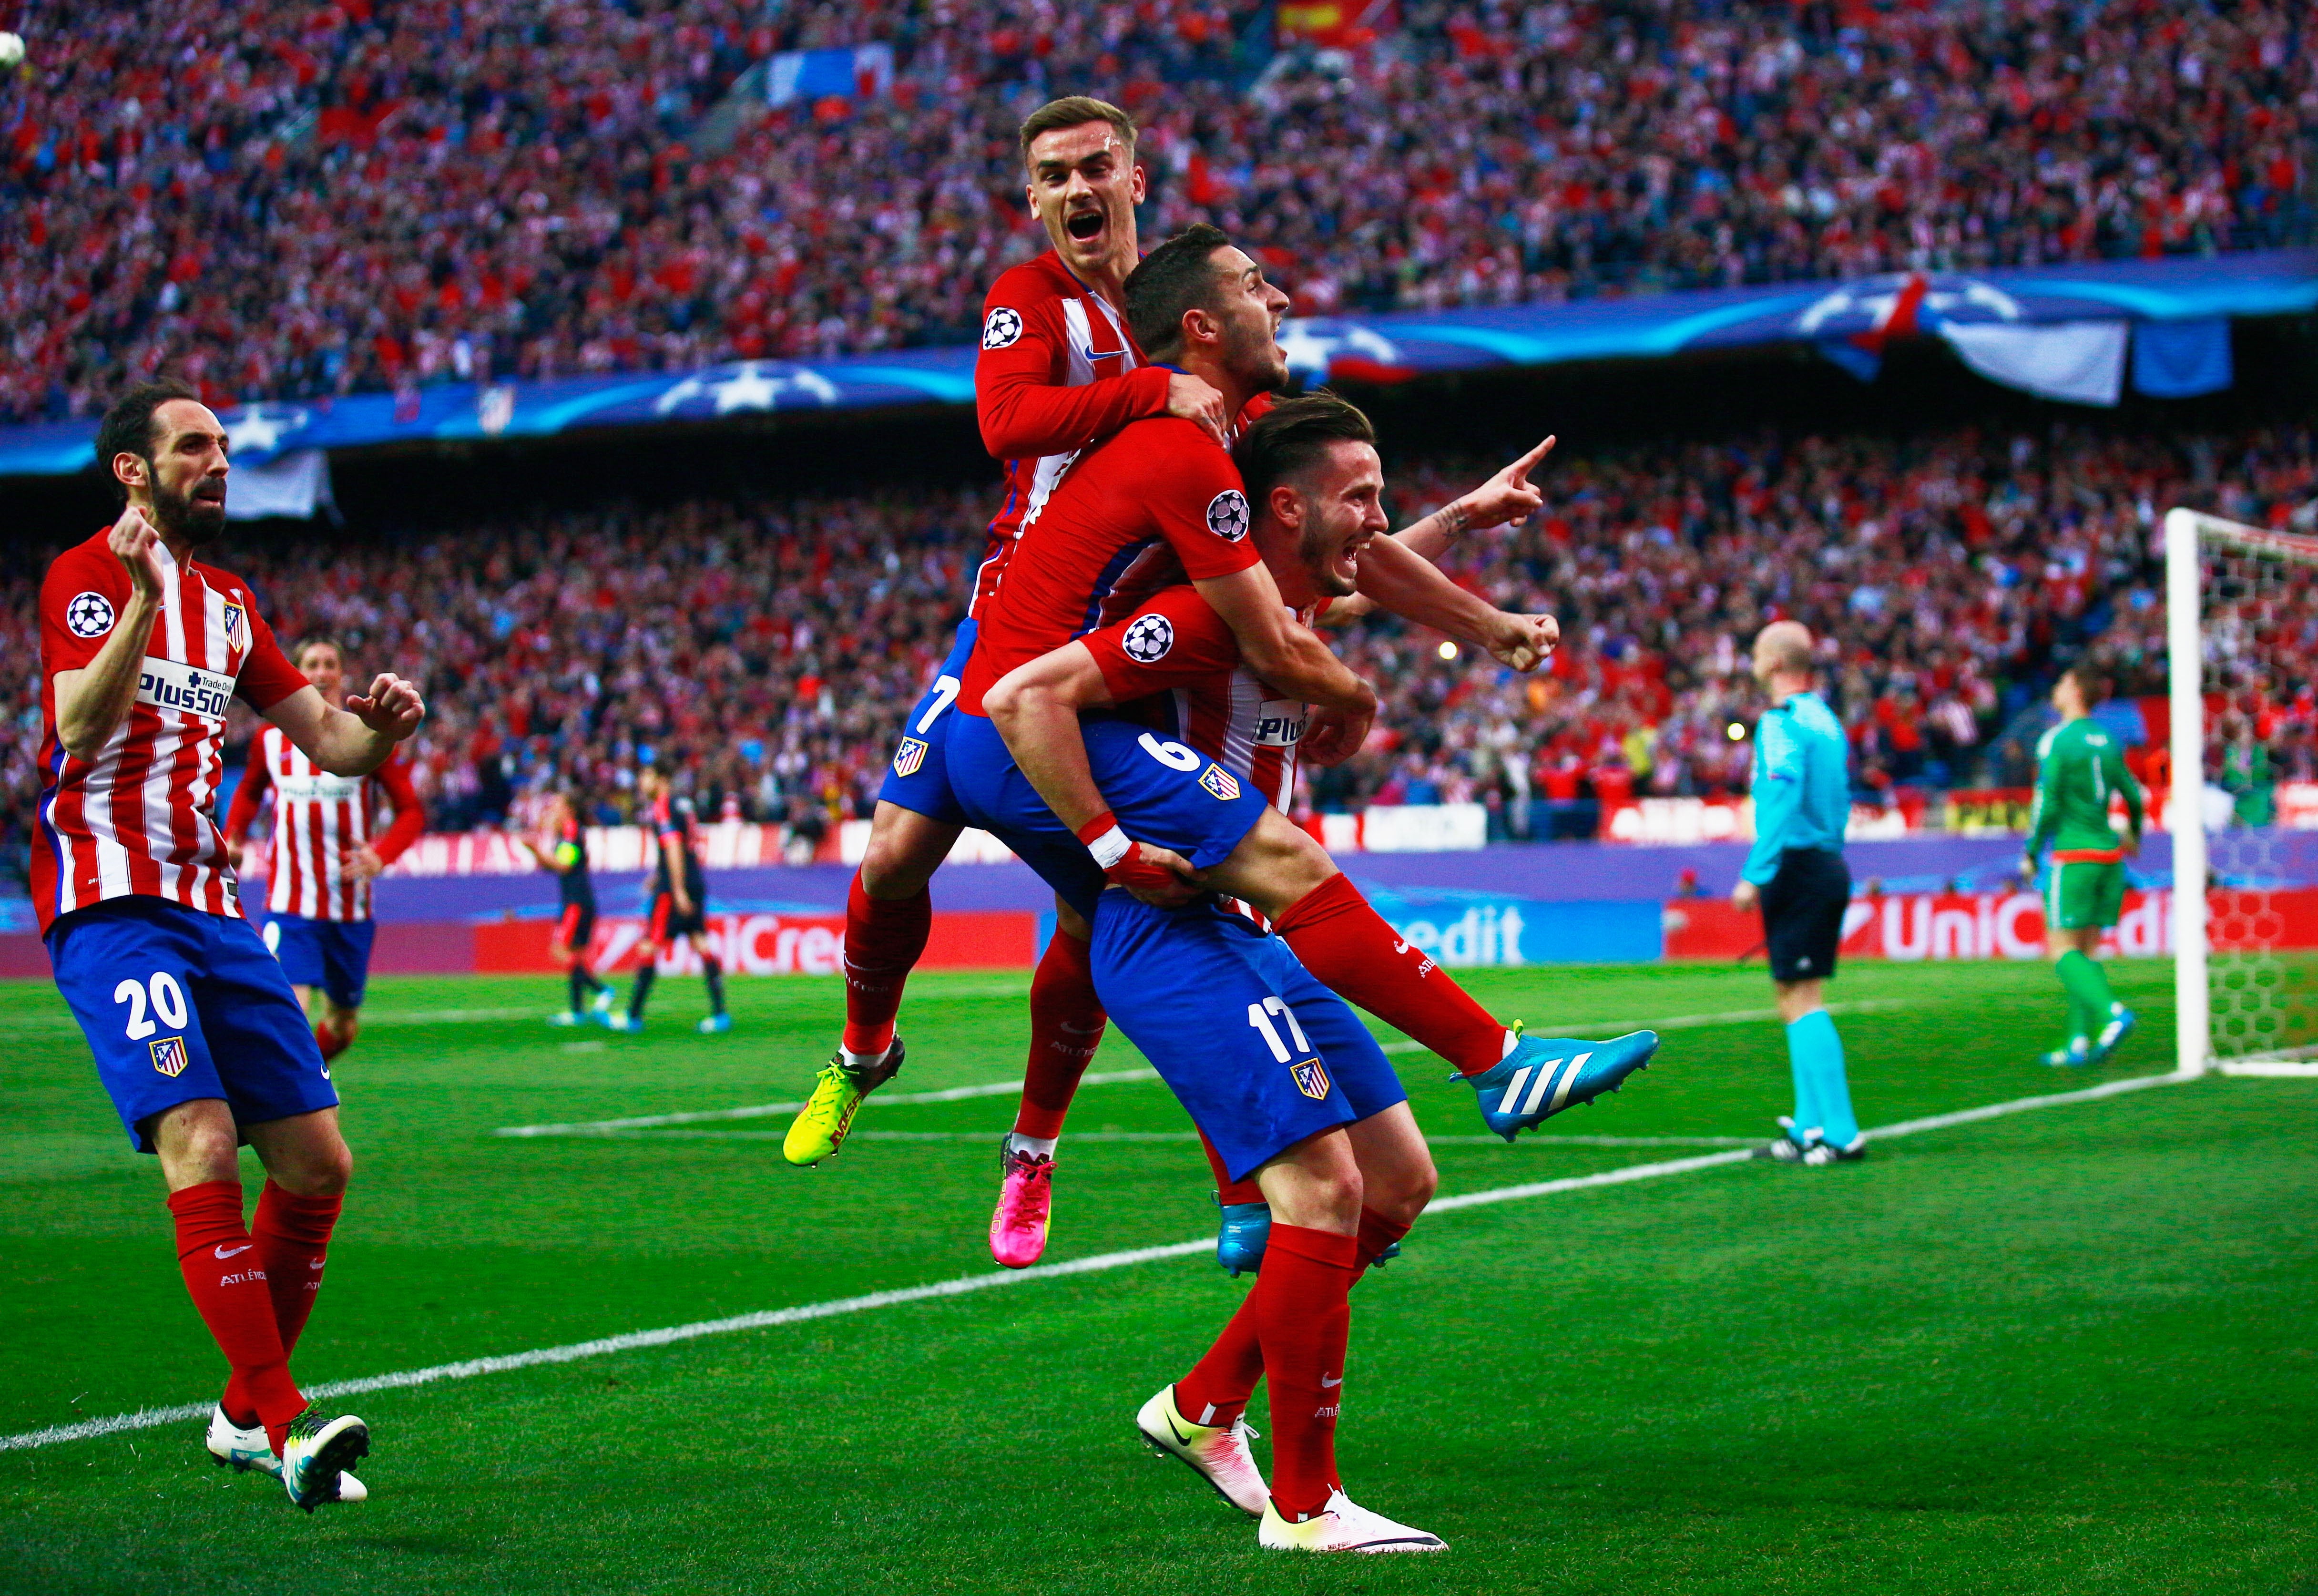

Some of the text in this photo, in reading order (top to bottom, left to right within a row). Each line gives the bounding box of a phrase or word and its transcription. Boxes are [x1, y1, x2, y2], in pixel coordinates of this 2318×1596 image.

[203, 677, 222, 689] Trade
[916, 675, 960, 734] 7
[1138, 733, 1201, 772] 6
[114, 972, 188, 1040] 20
[1248, 996, 1310, 1063] 17
